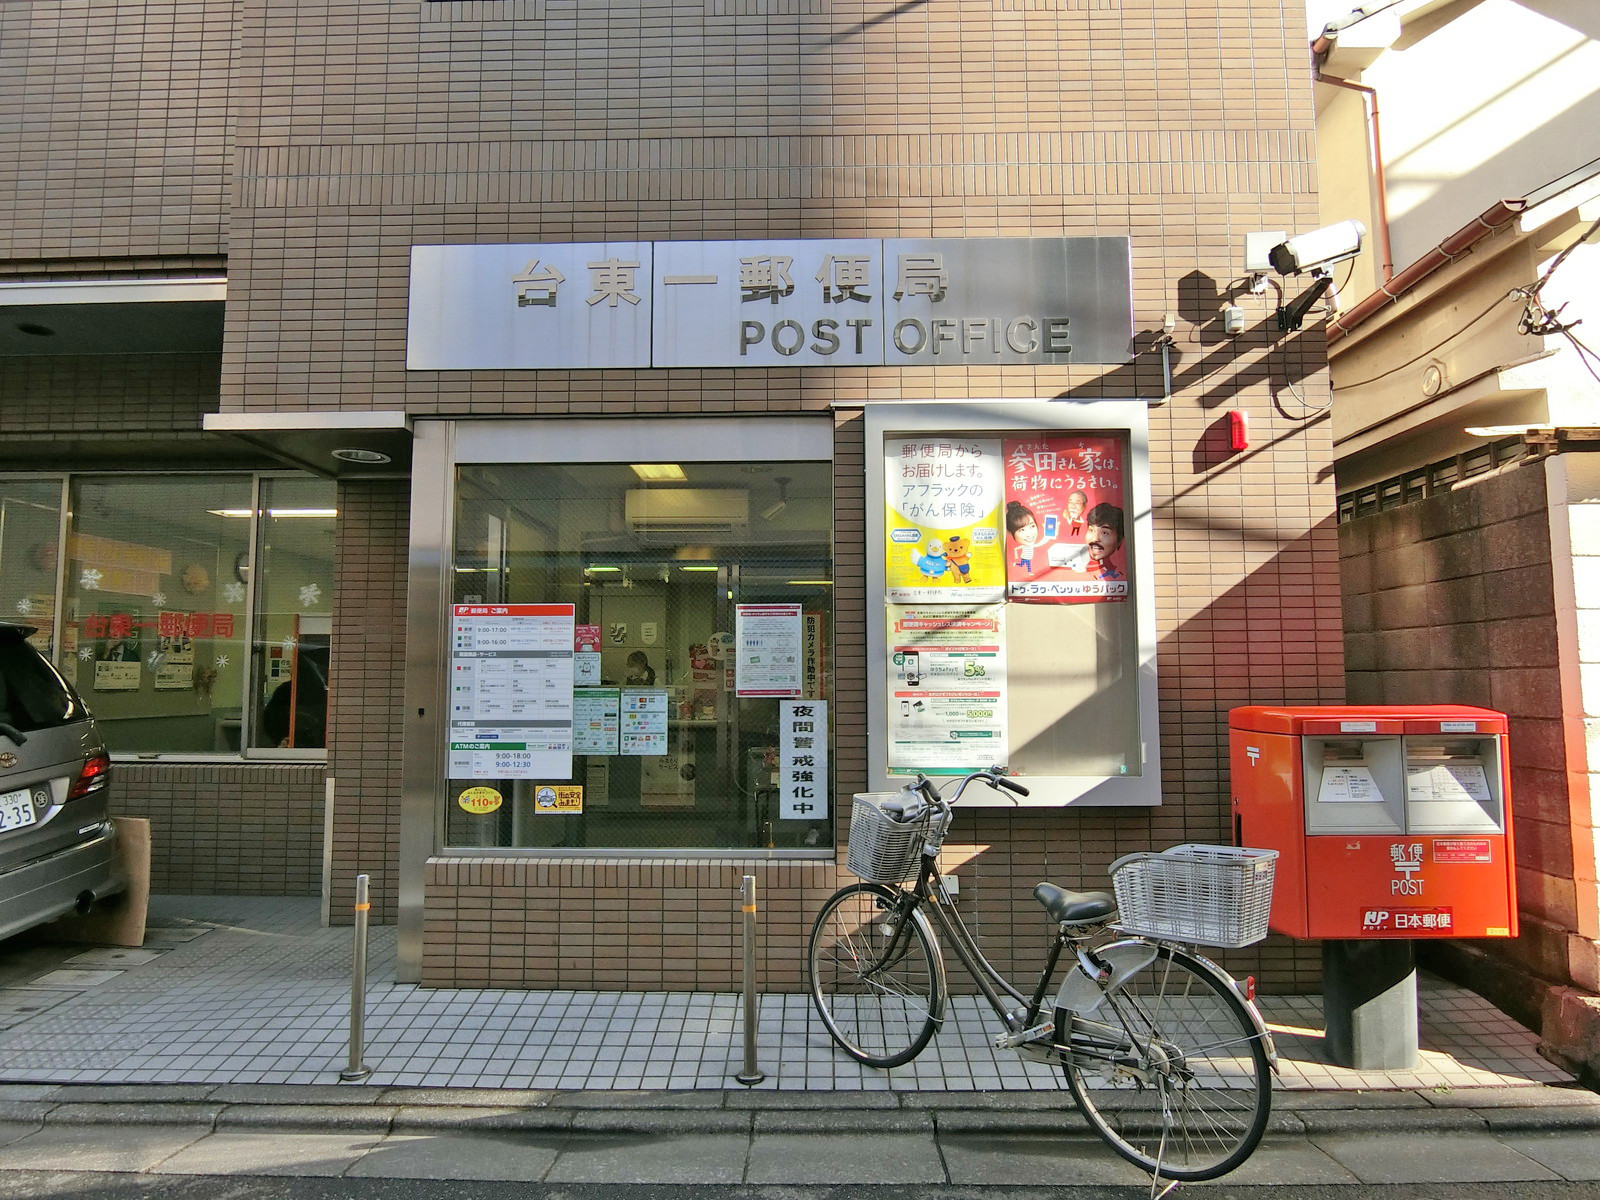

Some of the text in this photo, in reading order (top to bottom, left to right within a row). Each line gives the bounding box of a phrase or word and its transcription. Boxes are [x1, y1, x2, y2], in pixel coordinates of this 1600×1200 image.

[511, 253, 951, 308] 台東一郵便局
[740, 315, 1073, 356] POST OFFICE
[901, 443, 983, 459] 郵便局から
[902, 463, 983, 478] お届けします。
[902, 483, 983, 498] アフラックの
[1010, 474, 1118, 491] 荷物にうるさい。
[902, 502, 984, 518] 「がん保険」
[807, 616, 815, 698] 防犯カメラ作動中です
[964, 661, 986, 677] 5%
[792, 705, 814, 814] 夜間警戒強化中
[4, 794, 18, 805] 330
[1389, 843, 1424, 862] 郵便
[1391, 879, 1424, 895] POST
[1395, 913, 1451, 928] 日本郵便
